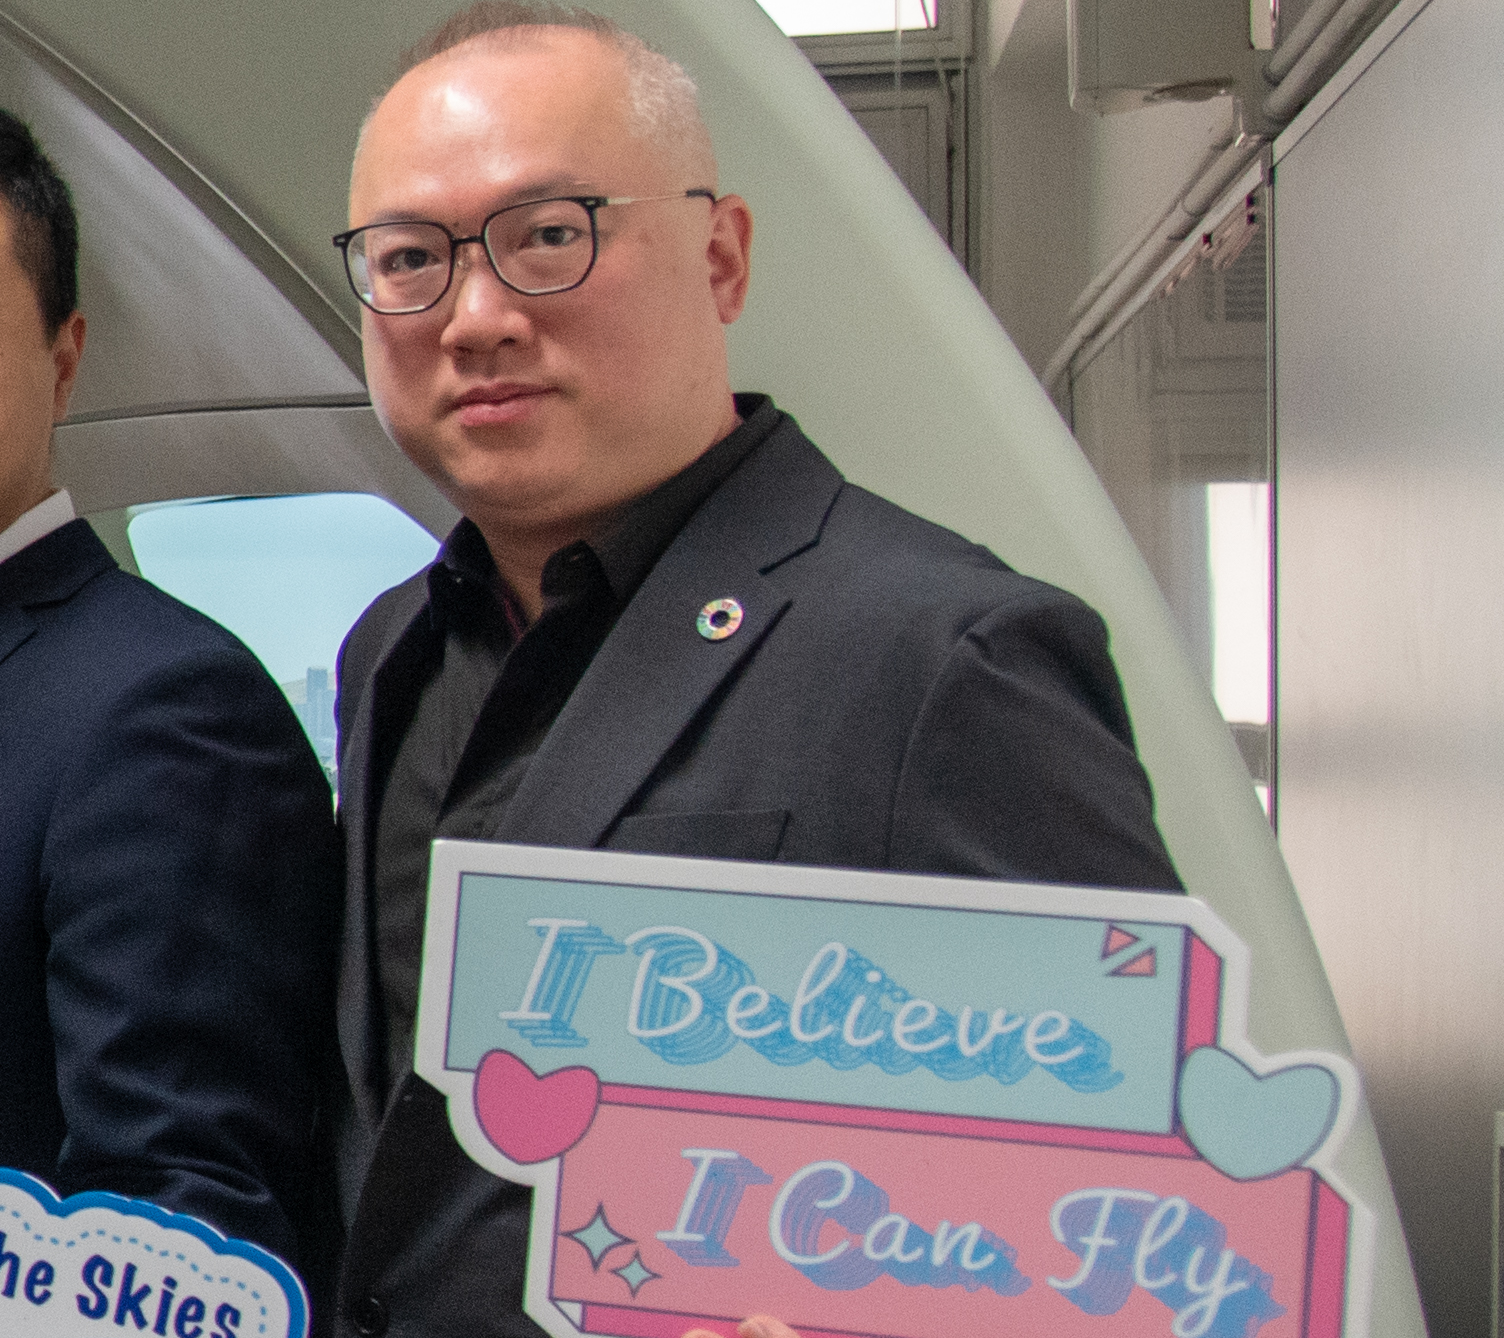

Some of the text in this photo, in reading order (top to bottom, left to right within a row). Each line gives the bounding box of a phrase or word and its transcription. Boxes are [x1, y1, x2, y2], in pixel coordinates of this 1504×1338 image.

[497, 918, 1124, 1094] I Believe
[656, 1147, 768, 1259] I
[769, 1160, 1033, 1291] Can
